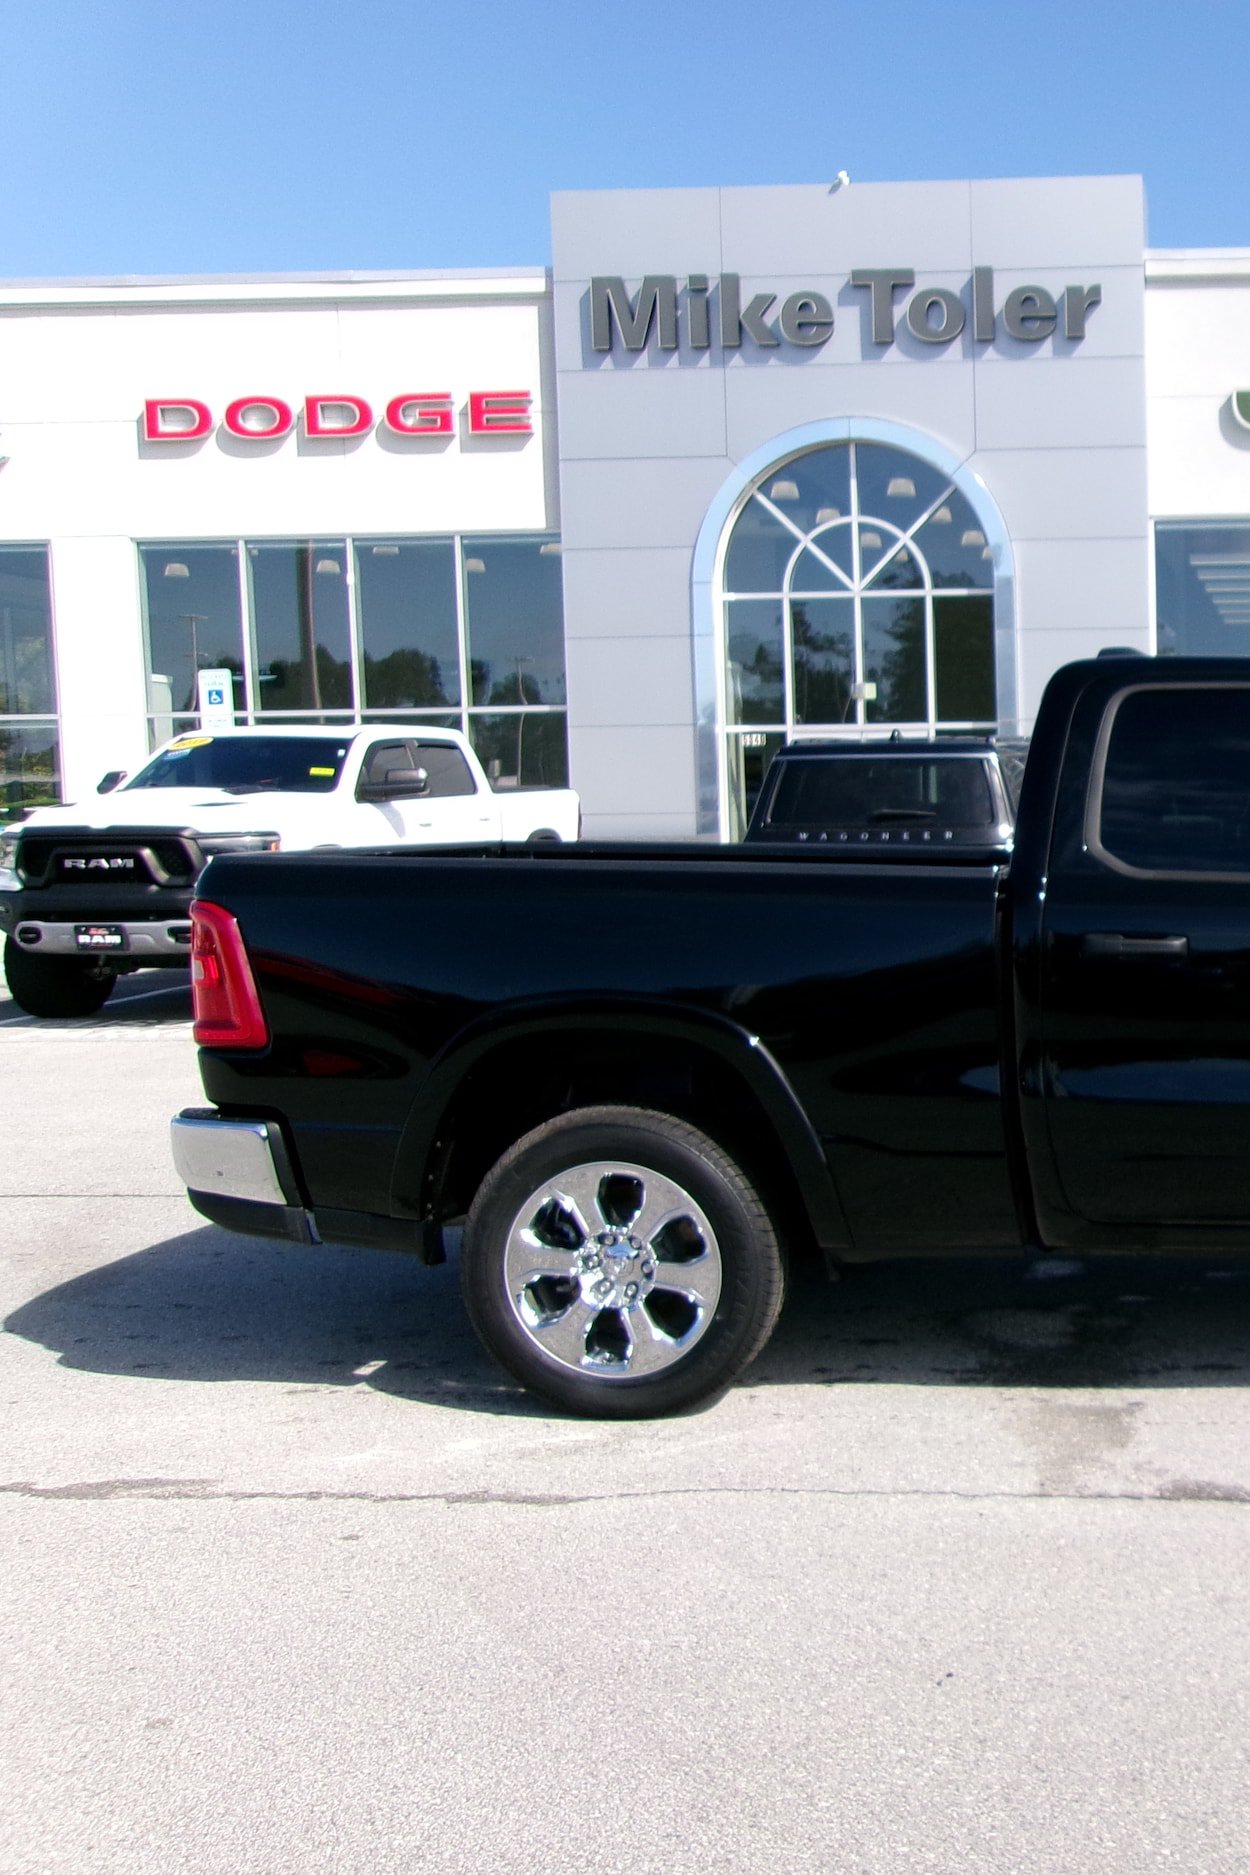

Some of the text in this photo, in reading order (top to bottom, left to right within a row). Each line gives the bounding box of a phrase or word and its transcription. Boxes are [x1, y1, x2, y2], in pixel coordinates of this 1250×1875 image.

[589, 265, 1102, 351] Mike Toler
[144, 390, 533, 441] DODGE
[799, 830, 953, 841] WAGONEER
[63, 858, 134, 869] RAM
[77, 934, 122, 945] RAM
